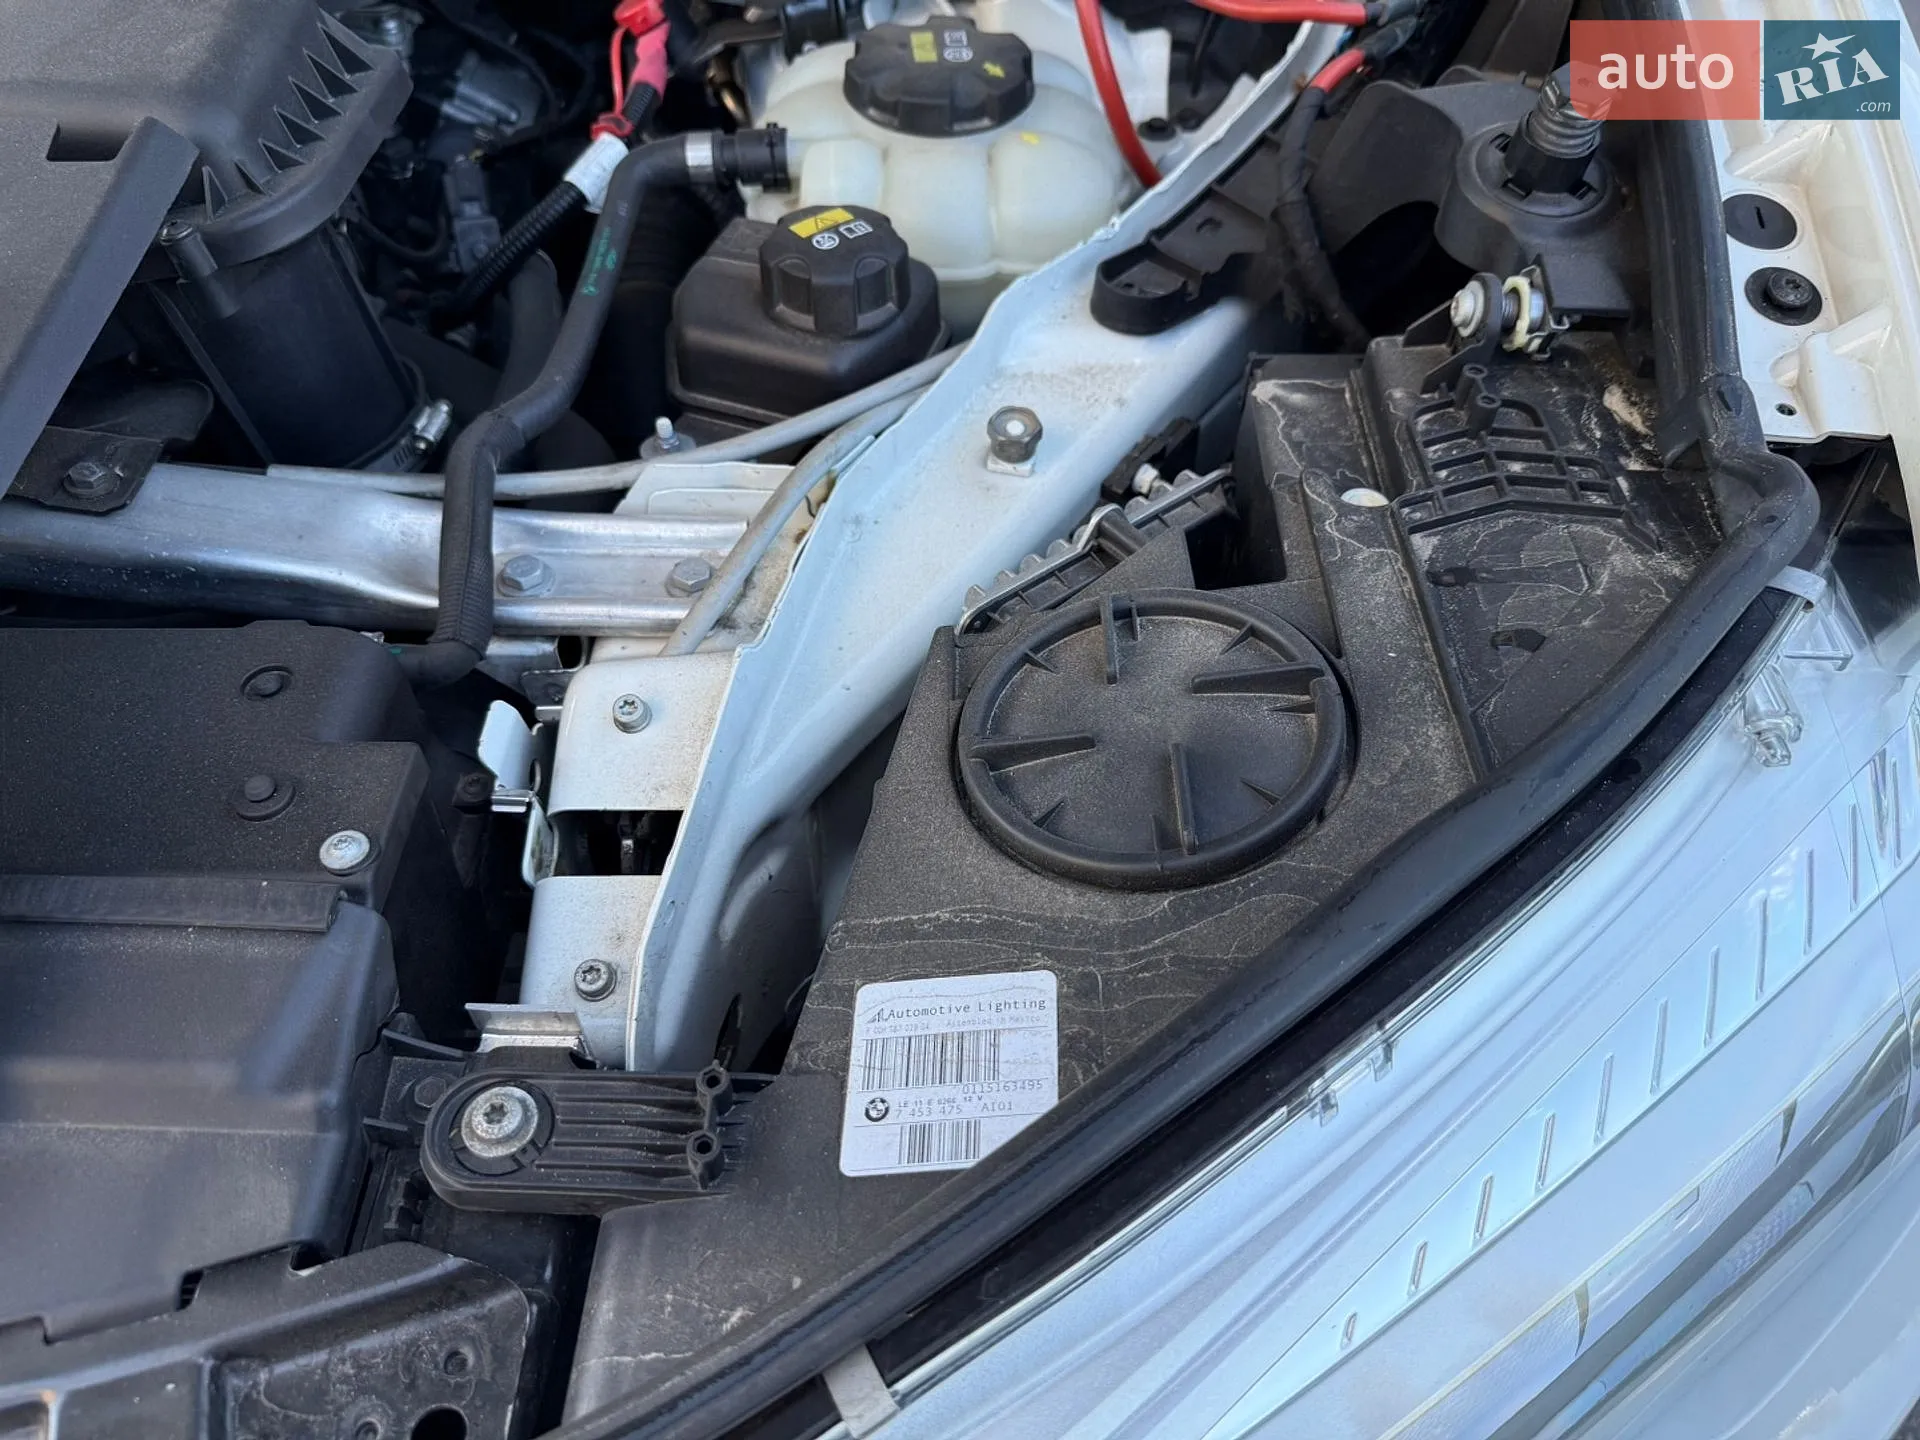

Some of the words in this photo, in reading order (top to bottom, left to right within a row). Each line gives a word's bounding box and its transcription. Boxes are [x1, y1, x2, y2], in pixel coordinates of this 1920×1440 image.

[888, 1001, 970, 1019] Automotive
[979, 998, 1046, 1012] Lighting
[908, 1106, 932, 1118] 453
[939, 1103, 962, 1115] 475
